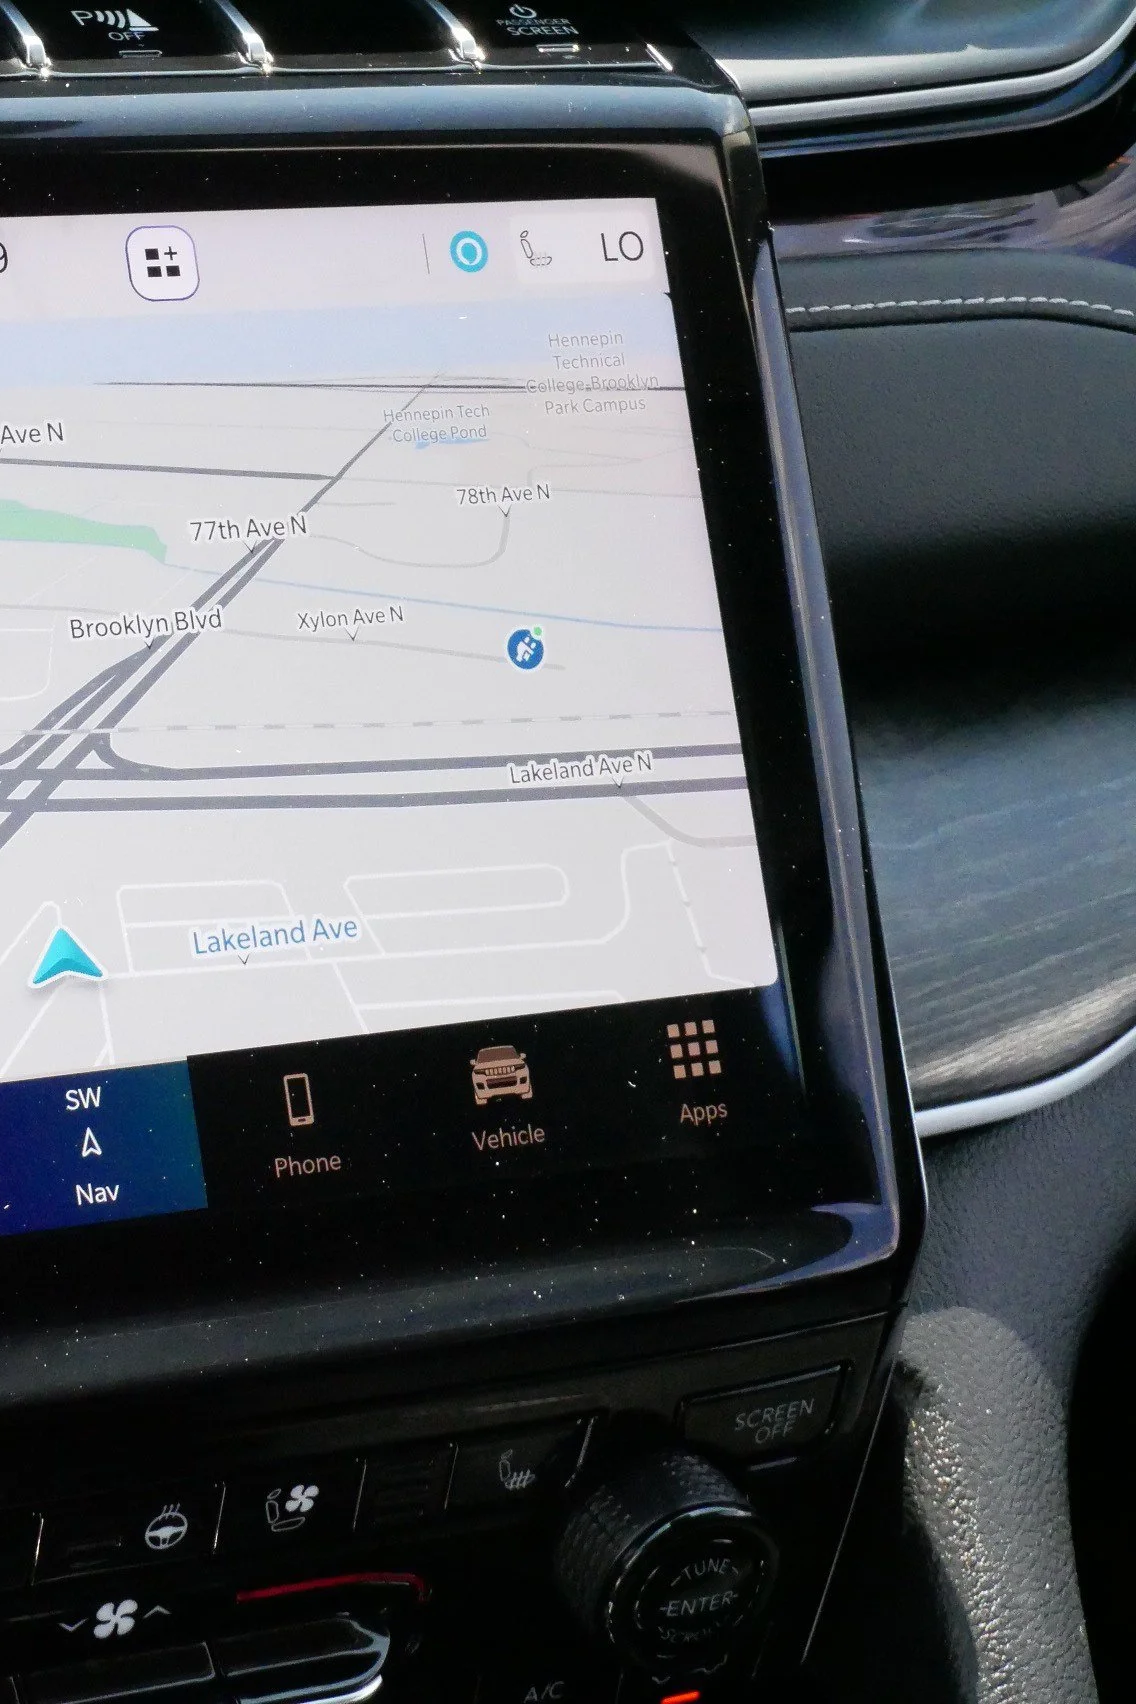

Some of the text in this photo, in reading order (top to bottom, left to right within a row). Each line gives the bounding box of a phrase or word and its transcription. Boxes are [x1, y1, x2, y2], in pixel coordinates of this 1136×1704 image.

[495, 18, 571, 26] PASSENGER
[506, 26, 580, 36] SCREEN
[107, 31, 145, 42] OFF
[600, 231, 644, 262] LO
[547, 330, 624, 349] Hennepin
[553, 352, 626, 370] Technical
[383, 404, 490, 422] Hennepin Tech
[544, 398, 646, 415] Park Campus
[0, 425, 41, 446] Ave
[45, 422, 65, 444] N
[392, 424, 487, 443] College Pond
[456, 483, 551, 506] 78th Ave N
[189, 515, 308, 542] 77th Ave N
[70, 608, 223, 640] Brooklyn Blvd
[297, 605, 405, 632] Xylon Ave N
[509, 753, 653, 785] Lakeland Ave N
[193, 917, 358, 956] Lakeland Ave
[65, 1086, 102, 1112] SW
[679, 1100, 728, 1126] Apps
[471, 1124, 546, 1152] Vehicle
[275, 1152, 342, 1178] Phone
[75, 1182, 120, 1206] Nav
[734, 1397, 816, 1432] SCREEN
[754, 1418, 796, 1445] OFF
[680, 1557, 732, 1581] TUNE
[665, 1590, 735, 1618] ENTER
[522, 1680, 566, 1704] A/C
